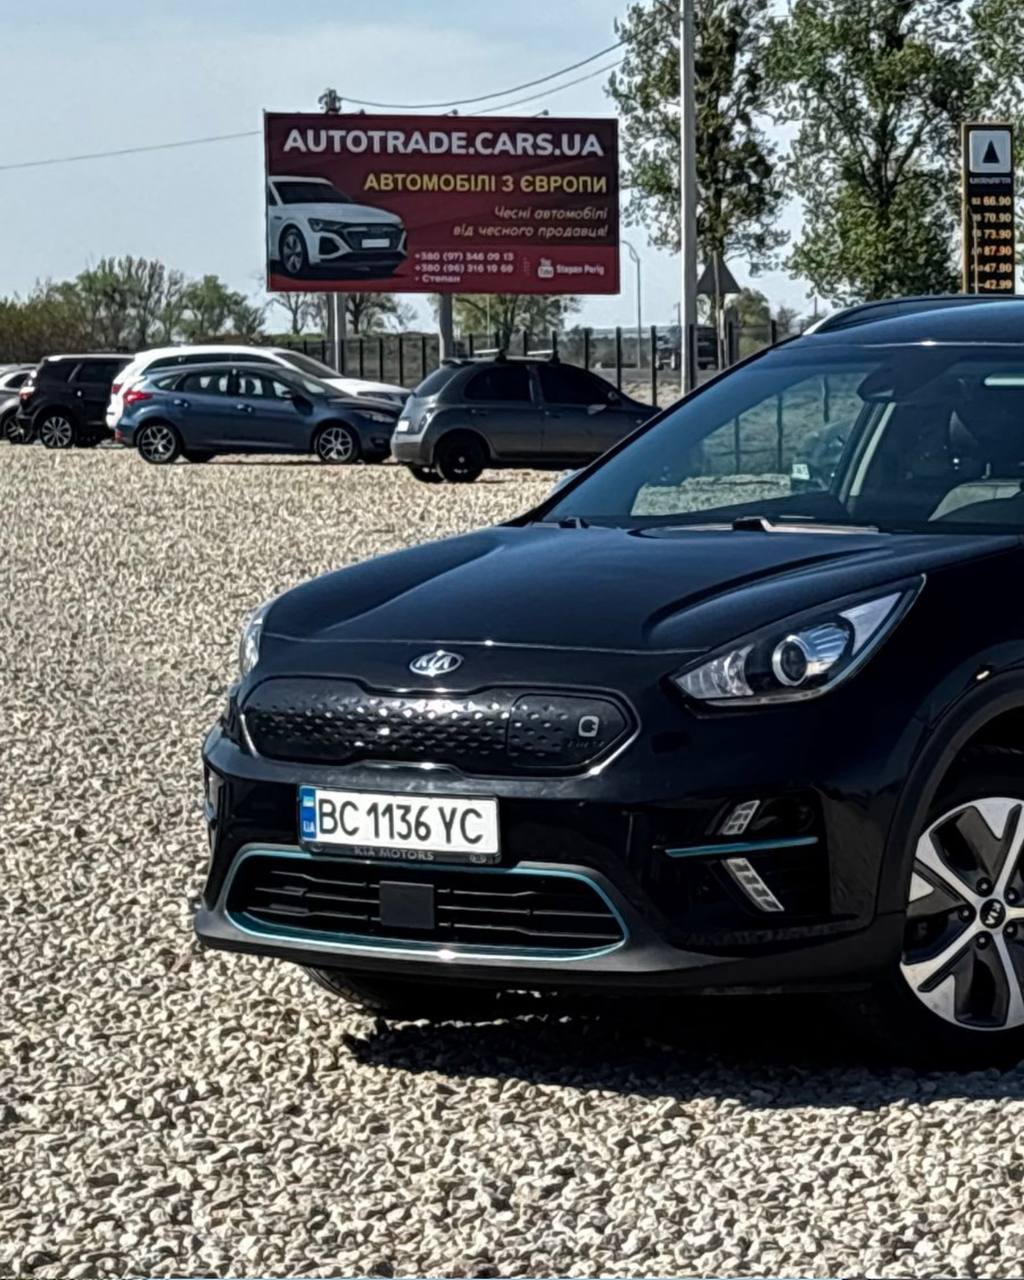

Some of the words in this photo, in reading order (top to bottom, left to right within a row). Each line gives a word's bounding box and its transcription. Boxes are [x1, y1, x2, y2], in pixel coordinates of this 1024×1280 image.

[283, 128, 604, 156] AUTOTRADE.CARS.UA
[364, 173, 496, 192] АВТОМОБІЛІ
[520, 175, 607, 193] ЄВРОПИ
[495, 206, 531, 219] Чесні
[534, 206, 608, 220] автомобілі
[453, 224, 474, 236] від
[478, 226, 534, 237] чесного
[303, 821, 316, 833] UA
[318, 799, 360, 836] BC
[366, 802, 432, 841] 1136
[438, 807, 484, 844] YC
[354, 846, 376, 858] KIA
[379, 848, 434, 862] MOTORS
